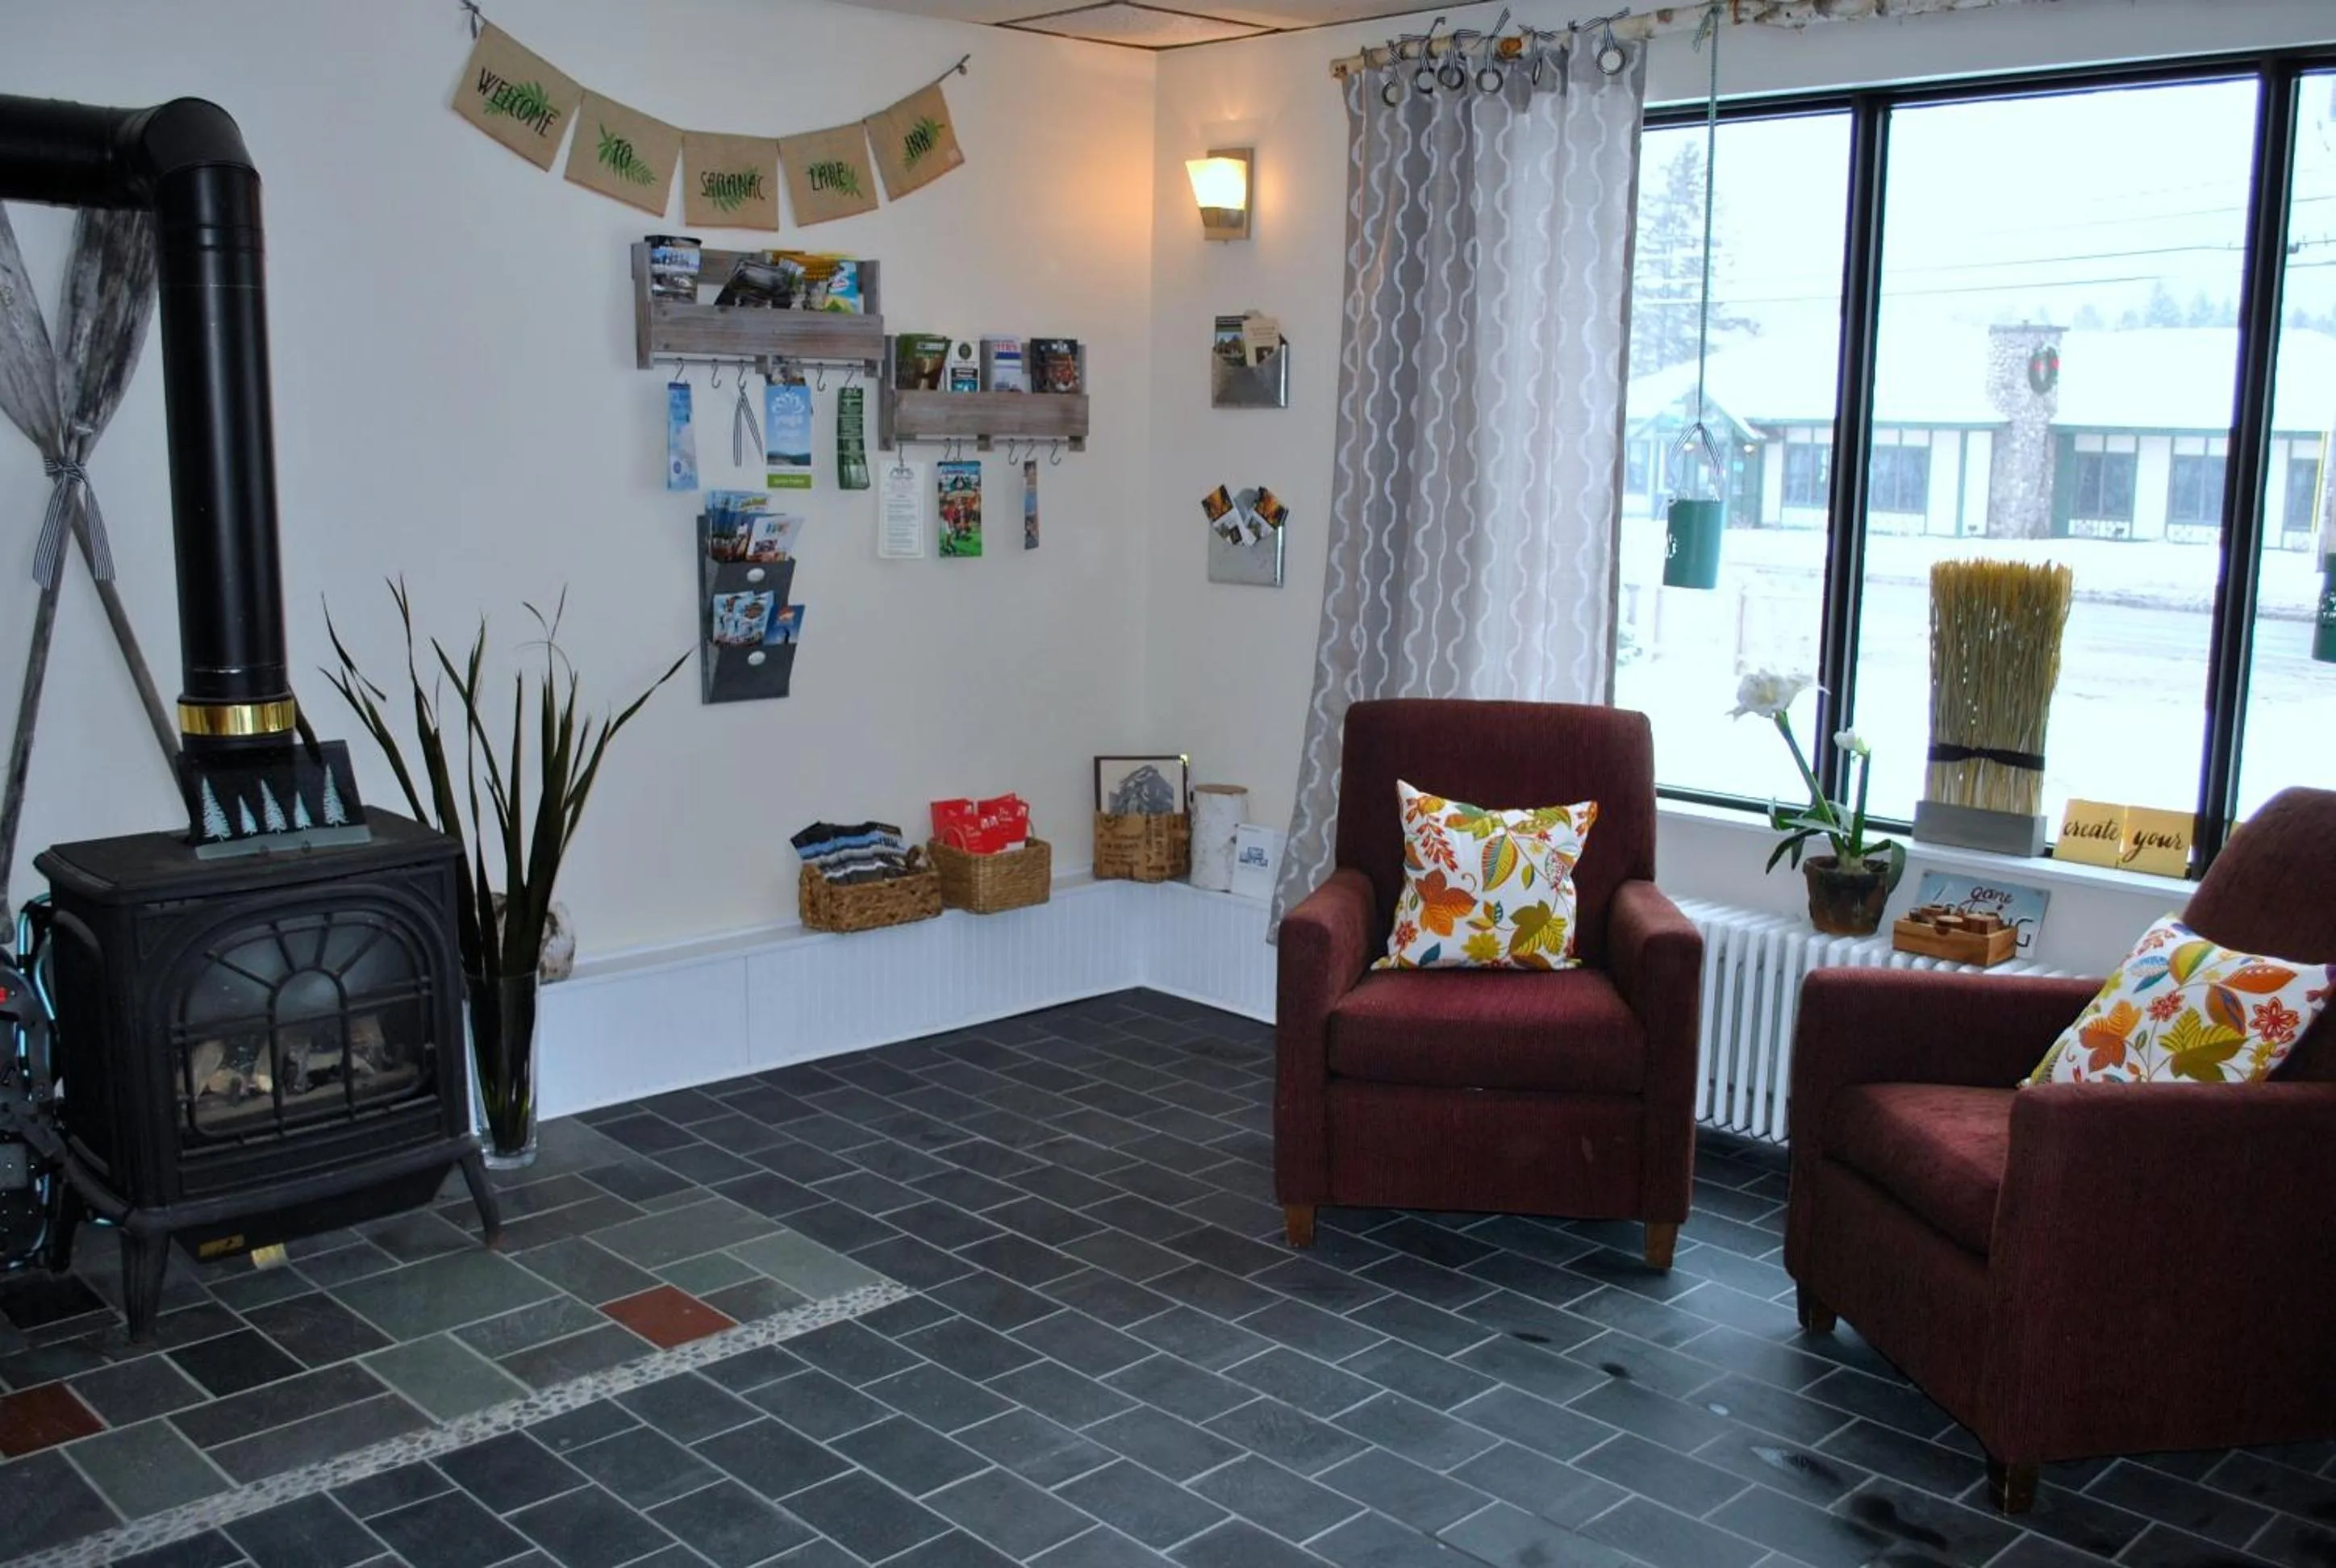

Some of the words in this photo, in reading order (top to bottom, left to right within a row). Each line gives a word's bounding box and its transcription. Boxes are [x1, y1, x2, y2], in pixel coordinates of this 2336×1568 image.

[477, 67, 557, 137] WELCOME
[613, 138, 633, 169] TO
[700, 170, 765, 201] SARANAC
[807, 161, 848, 191] LAKE
[903, 128, 932, 158] INN
[2063, 818, 2120, 841] create
[2121, 828, 2184, 863] your
